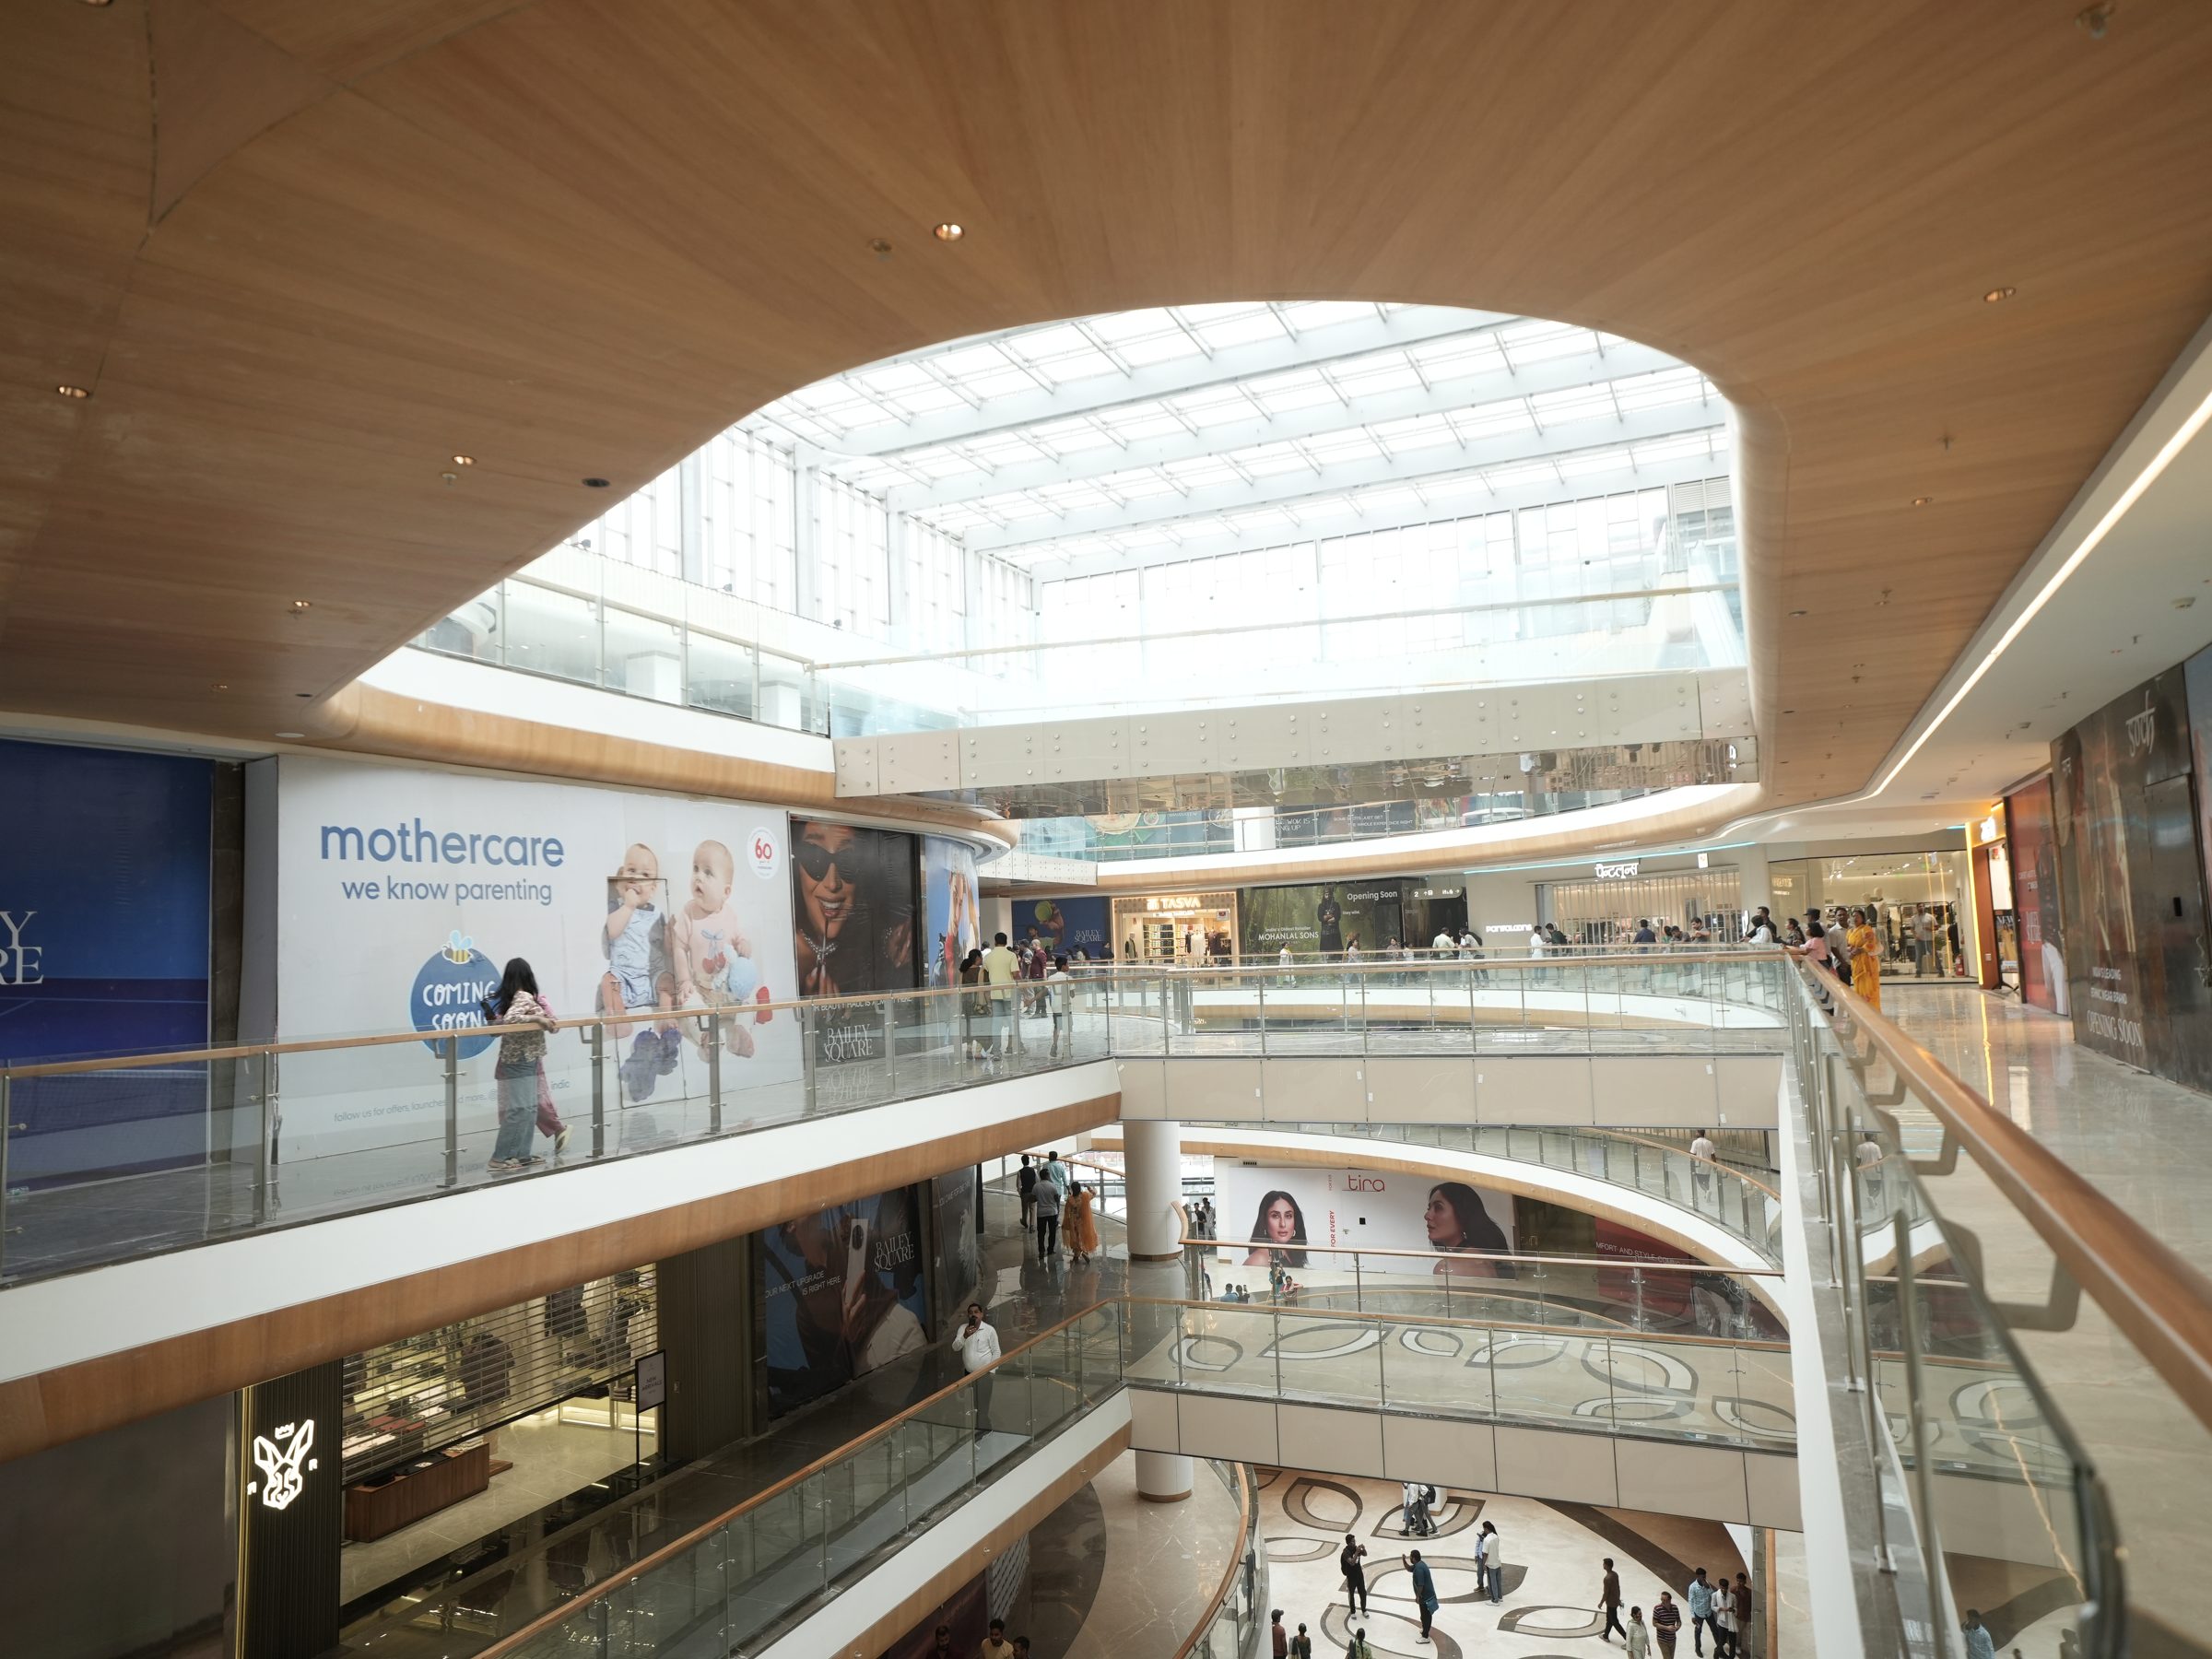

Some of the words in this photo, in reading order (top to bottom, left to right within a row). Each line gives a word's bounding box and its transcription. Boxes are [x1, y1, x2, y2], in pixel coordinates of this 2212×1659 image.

[321, 818, 564, 867] mothercare
[755, 837, 772, 860] 60
[342, 881, 381, 900] we
[387, 876, 449, 900] know
[455, 878, 552, 906] parenting
[1347, 892, 1379, 902] Opening
[1380, 890, 1398, 900] Soon
[1161, 897, 1201, 909] TASVA
[1258, 931, 1299, 942] MOHANLAL
[1300, 930, 1319, 940] SONS
[422, 981, 497, 1006] COMING
[827, 1023, 871, 1046] BAILEY
[2117, 1018, 2143, 1048] SOON
[824, 1038, 874, 1064] SQUARE
[1347, 1173, 1385, 1193] tira
[875, 1230, 912, 1259] BAILEY
[1595, 1241, 1618, 1253] MFORT
[874, 1243, 915, 1273] SQUARE
[779, 1280, 795, 1293] NEXT
[796, 1269, 825, 1287] UPGRADE
[808, 1280, 826, 1295] RIGHT
[826, 1275, 841, 1287] HERE
